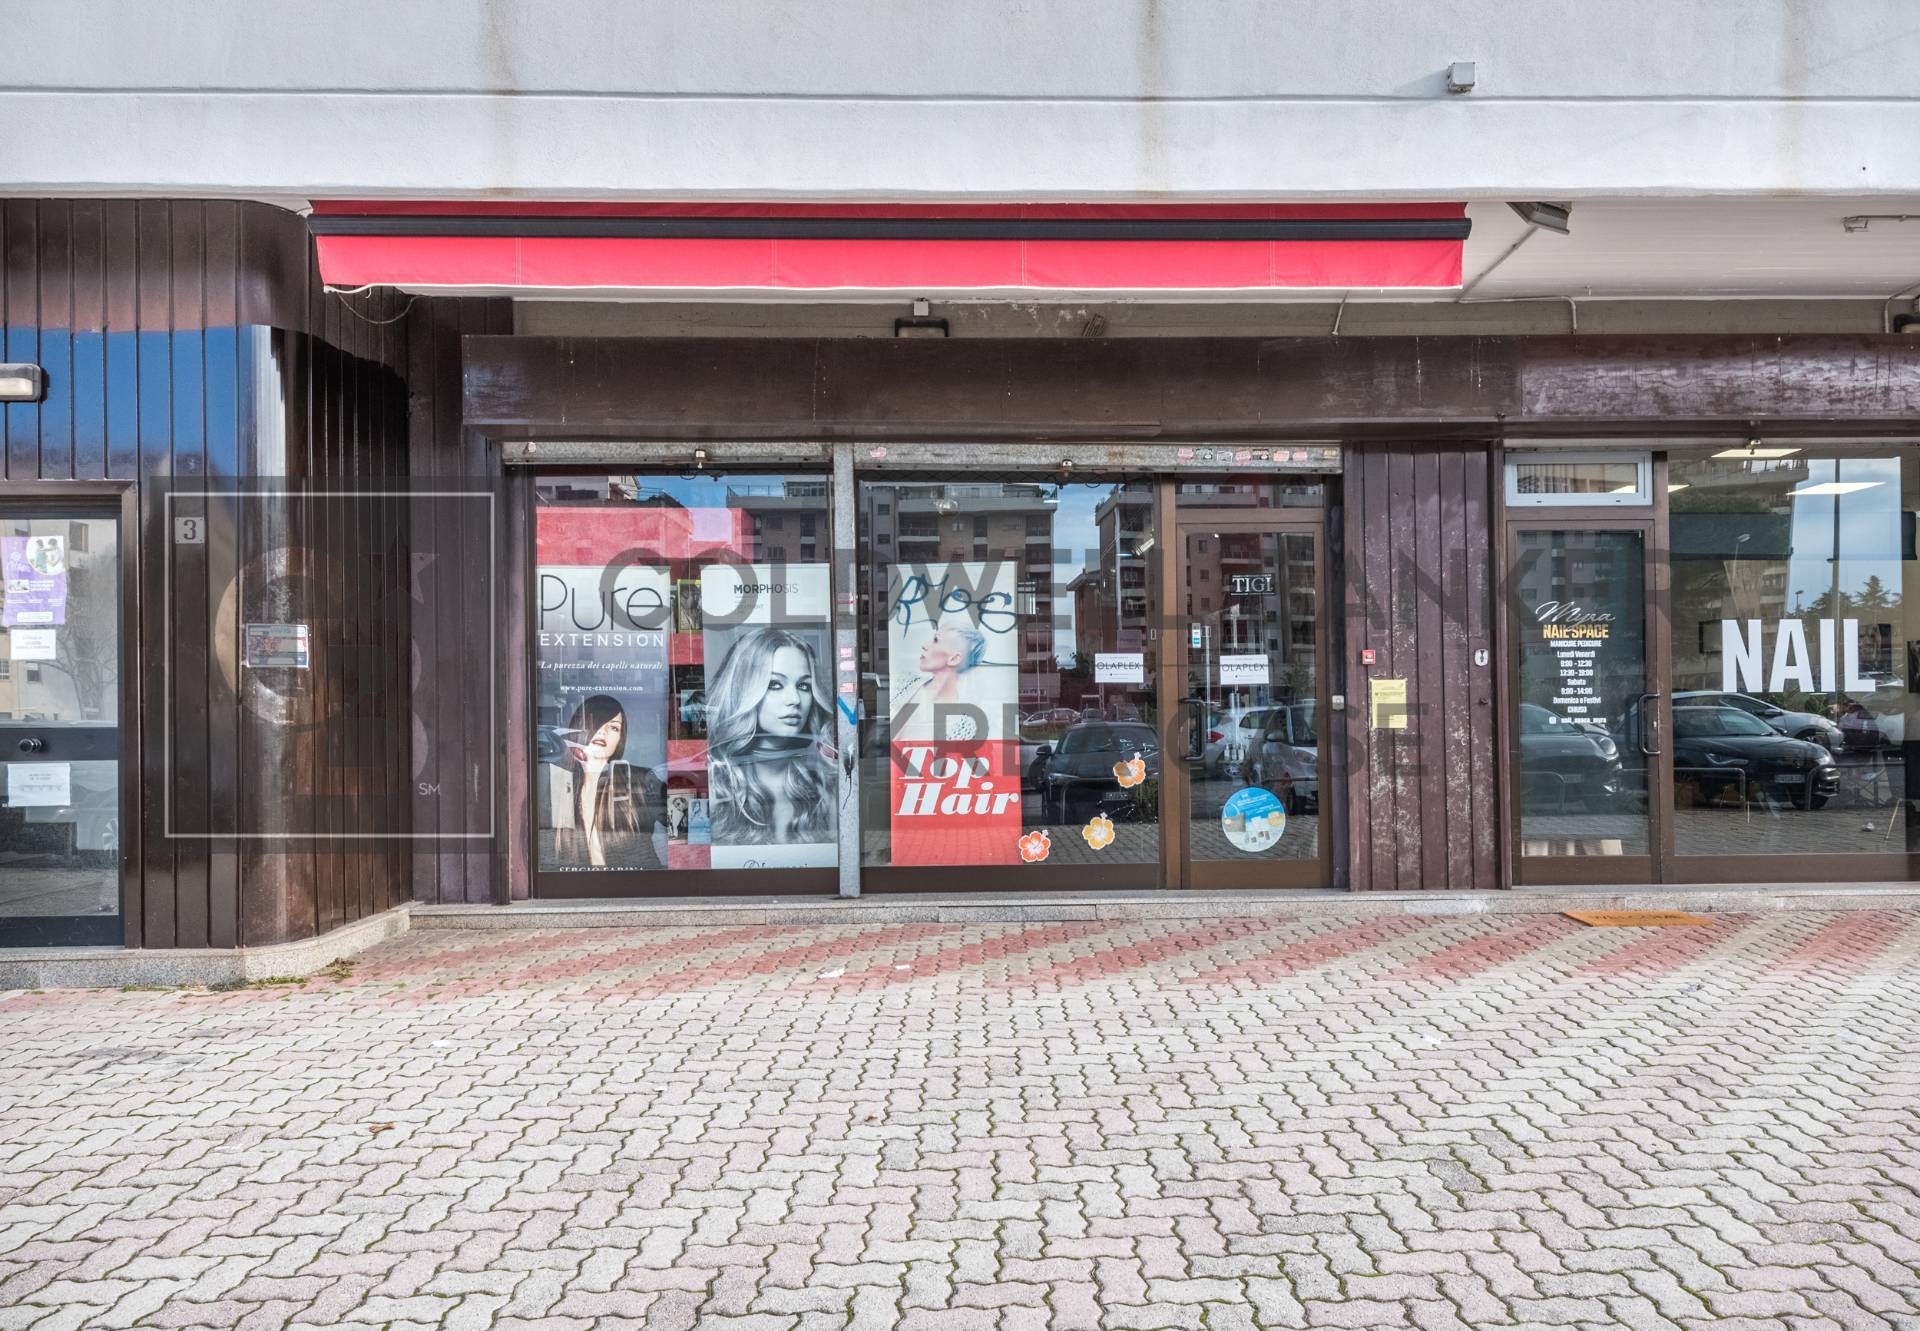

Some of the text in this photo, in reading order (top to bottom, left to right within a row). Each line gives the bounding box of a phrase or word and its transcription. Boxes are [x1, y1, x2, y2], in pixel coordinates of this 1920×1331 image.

[184, 519, 196, 540] 3
[734, 584, 798, 594] MORPHOSIS
[1231, 577, 1272, 592] TIGI
[541, 574, 663, 630] Pure
[1543, 624, 1609, 638] NAIL SPACE
[540, 633, 664, 647] EXTENSION
[1722, 619, 1876, 692] NAIL
[601, 661, 628, 671] capelli
[630, 660, 663, 669] naturali
[1096, 661, 1140, 670] OLAPLEX
[1222, 663, 1265, 671] OLAPLEX
[560, 684, 643, 693] www.pure-extension.com
[898, 747, 989, 789] Top
[895, 782, 1019, 815] Hair
